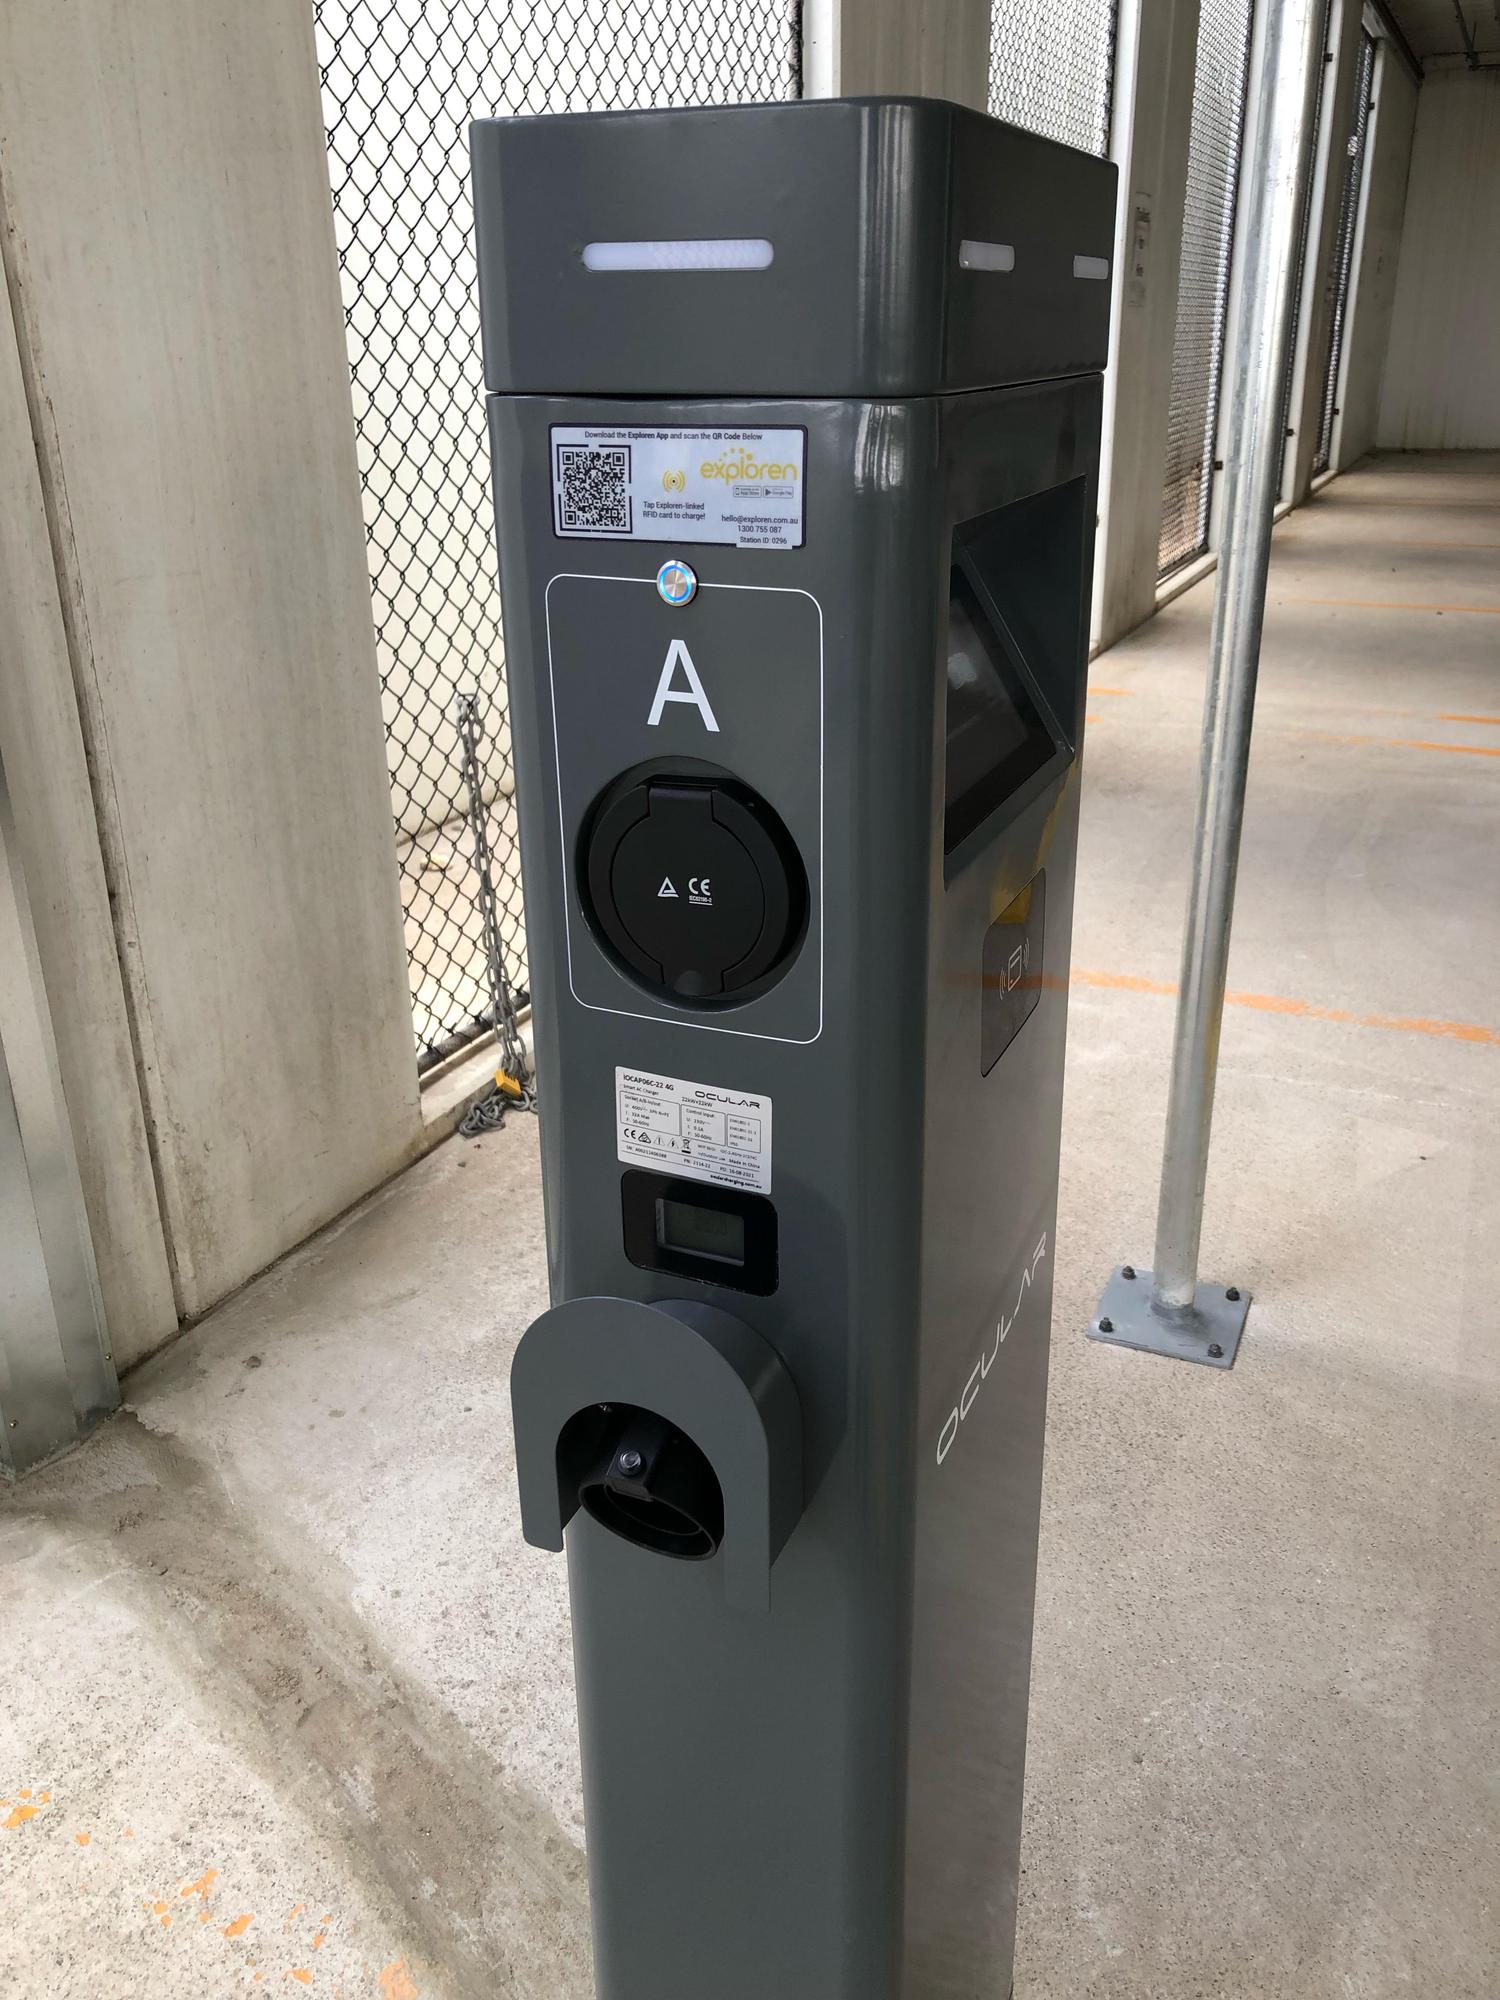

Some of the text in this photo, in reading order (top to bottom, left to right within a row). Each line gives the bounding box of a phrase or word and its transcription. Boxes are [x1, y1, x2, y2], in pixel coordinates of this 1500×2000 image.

[628, 432, 655, 440] Exploren
[656, 432, 668, 440] App
[700, 450, 798, 485] exploren
[656, 502, 704, 510] Exploren-linked
[682, 512, 705, 521] charge!
[721, 515, 798, 524] hello@exploren.com.au
[740, 536, 761, 544] Station
[647, 639, 720, 732] A
[695, 1091, 760, 1109] OCULAR
[936, 1231, 1046, 1465] OCULAR
